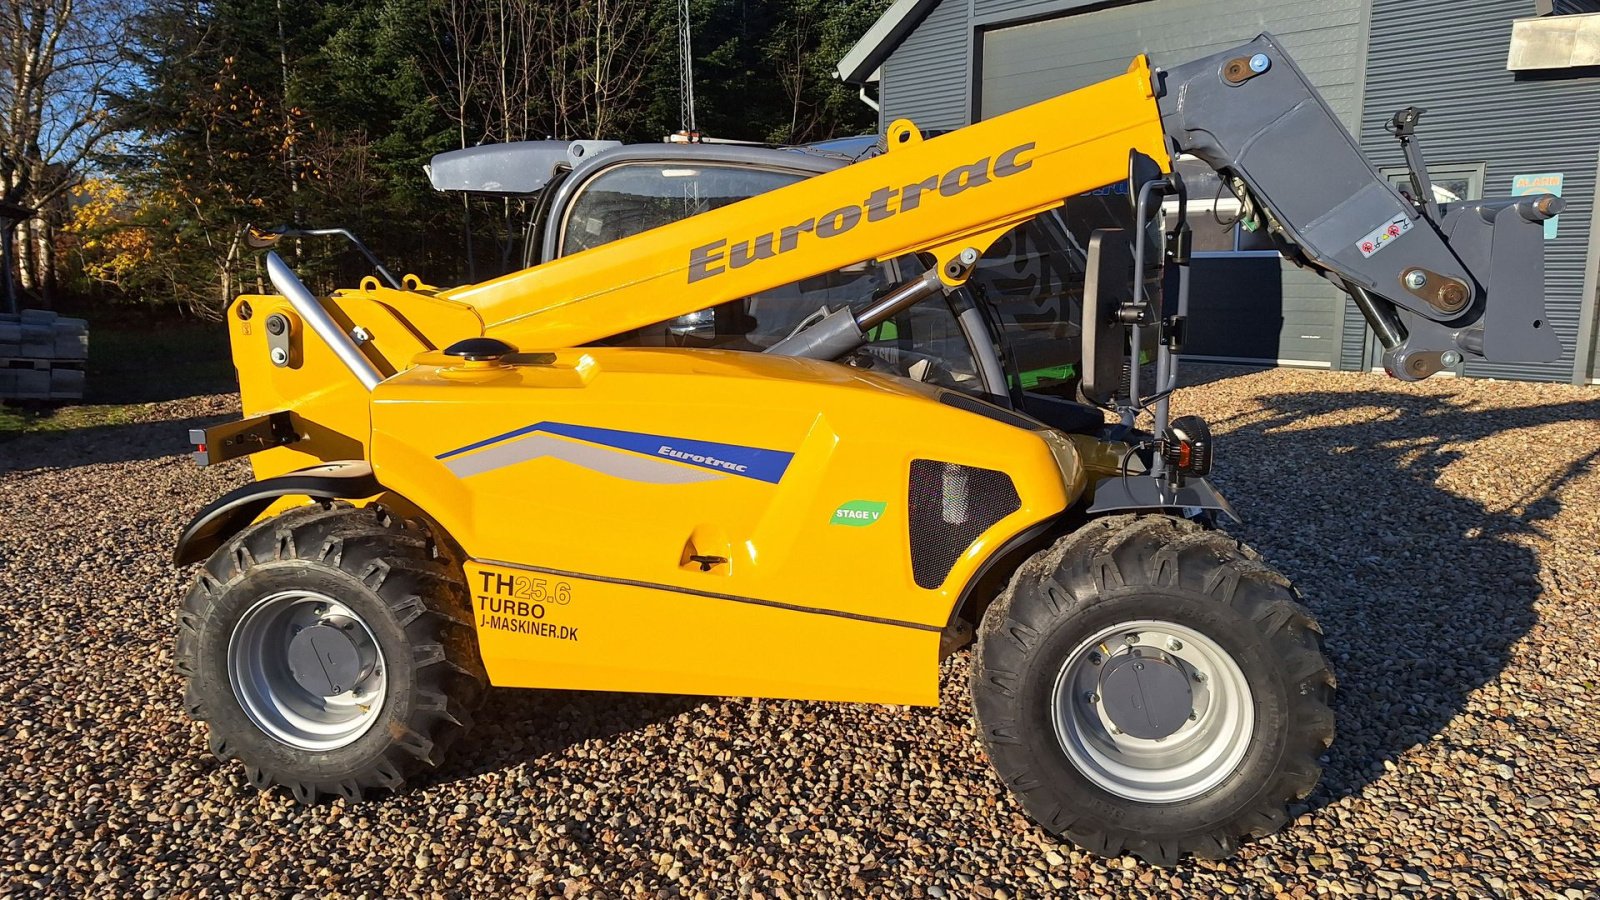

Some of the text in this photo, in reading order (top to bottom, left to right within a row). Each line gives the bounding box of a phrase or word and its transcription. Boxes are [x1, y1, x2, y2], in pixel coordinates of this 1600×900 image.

[687, 142, 1036, 284] Eurotrac
[658, 445, 748, 473] Eurotrac
[836, 509, 880, 520] STAGE V
[479, 571, 571, 605] TH25.6
[478, 595, 545, 619] TURBO
[480, 614, 578, 641] J-MASKINER.DK
